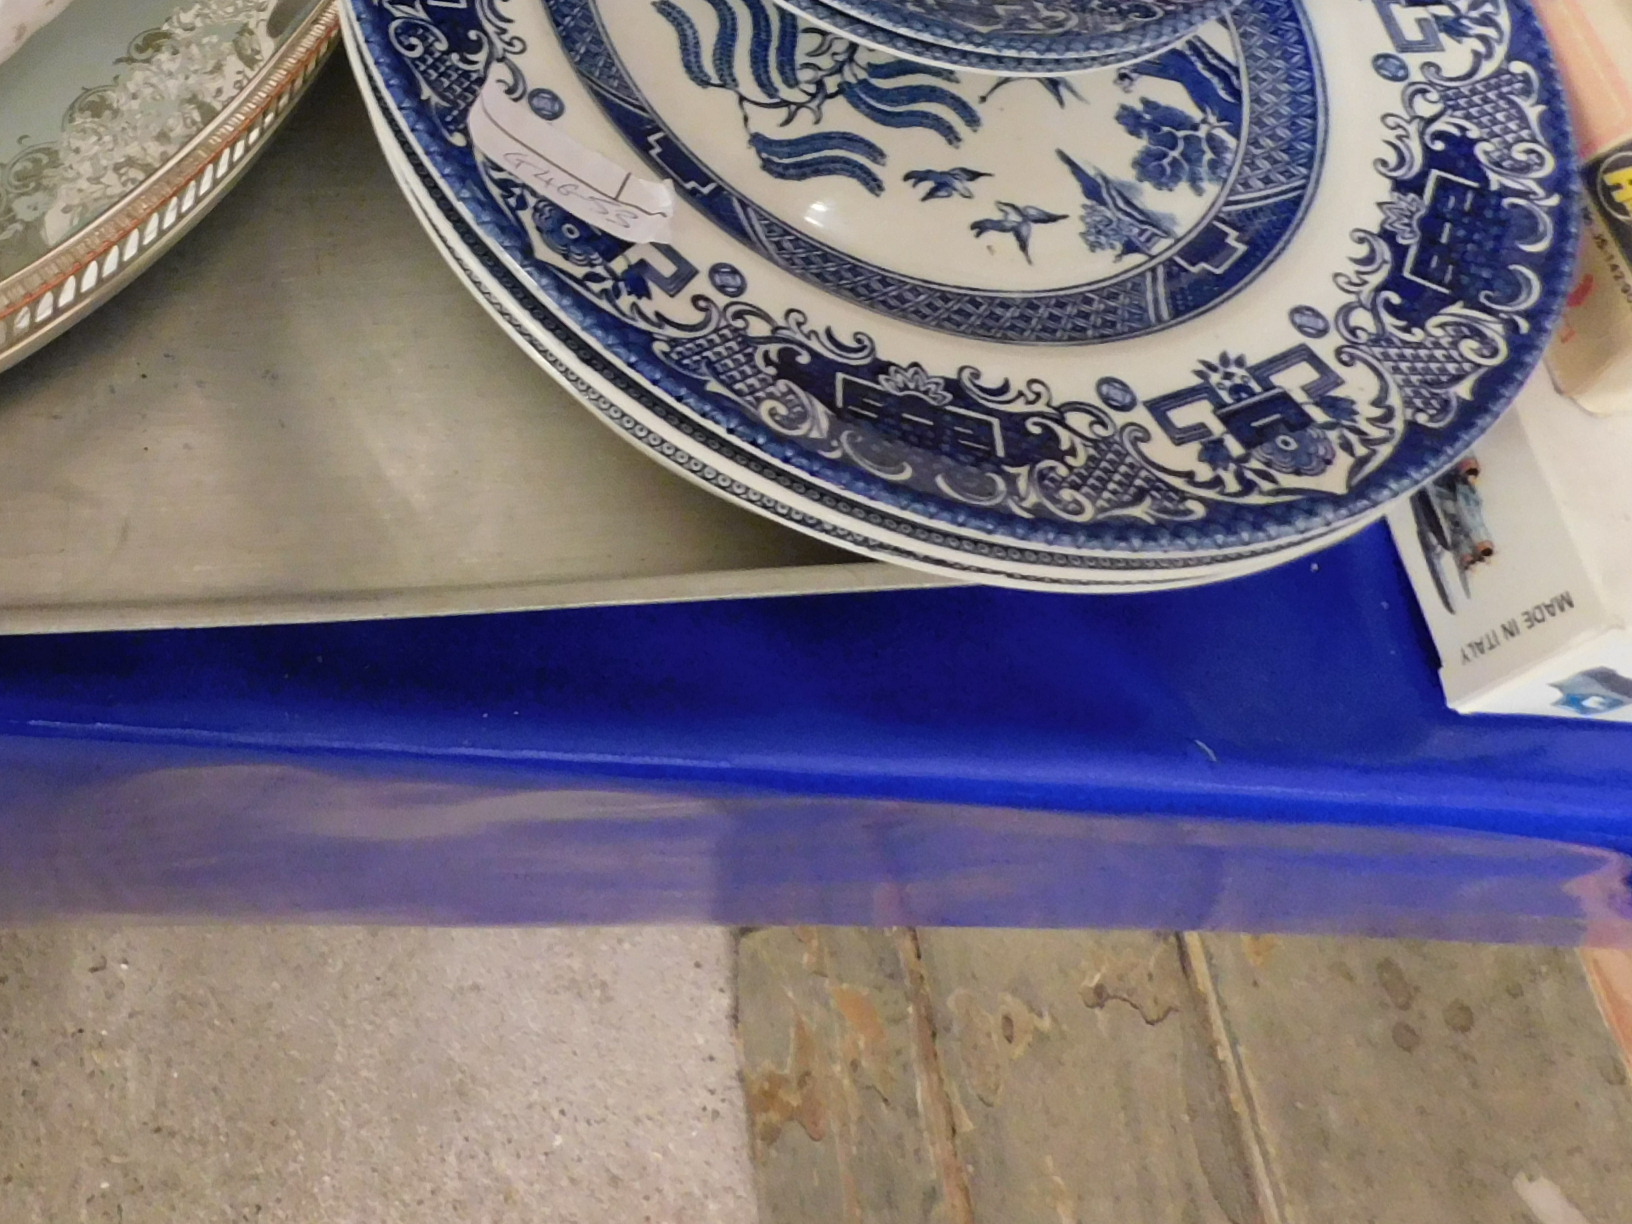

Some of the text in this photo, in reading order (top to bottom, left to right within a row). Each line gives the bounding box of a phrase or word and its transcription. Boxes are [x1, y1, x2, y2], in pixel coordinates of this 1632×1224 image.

[1460, 589, 1575, 666] MADE IN ITALY
